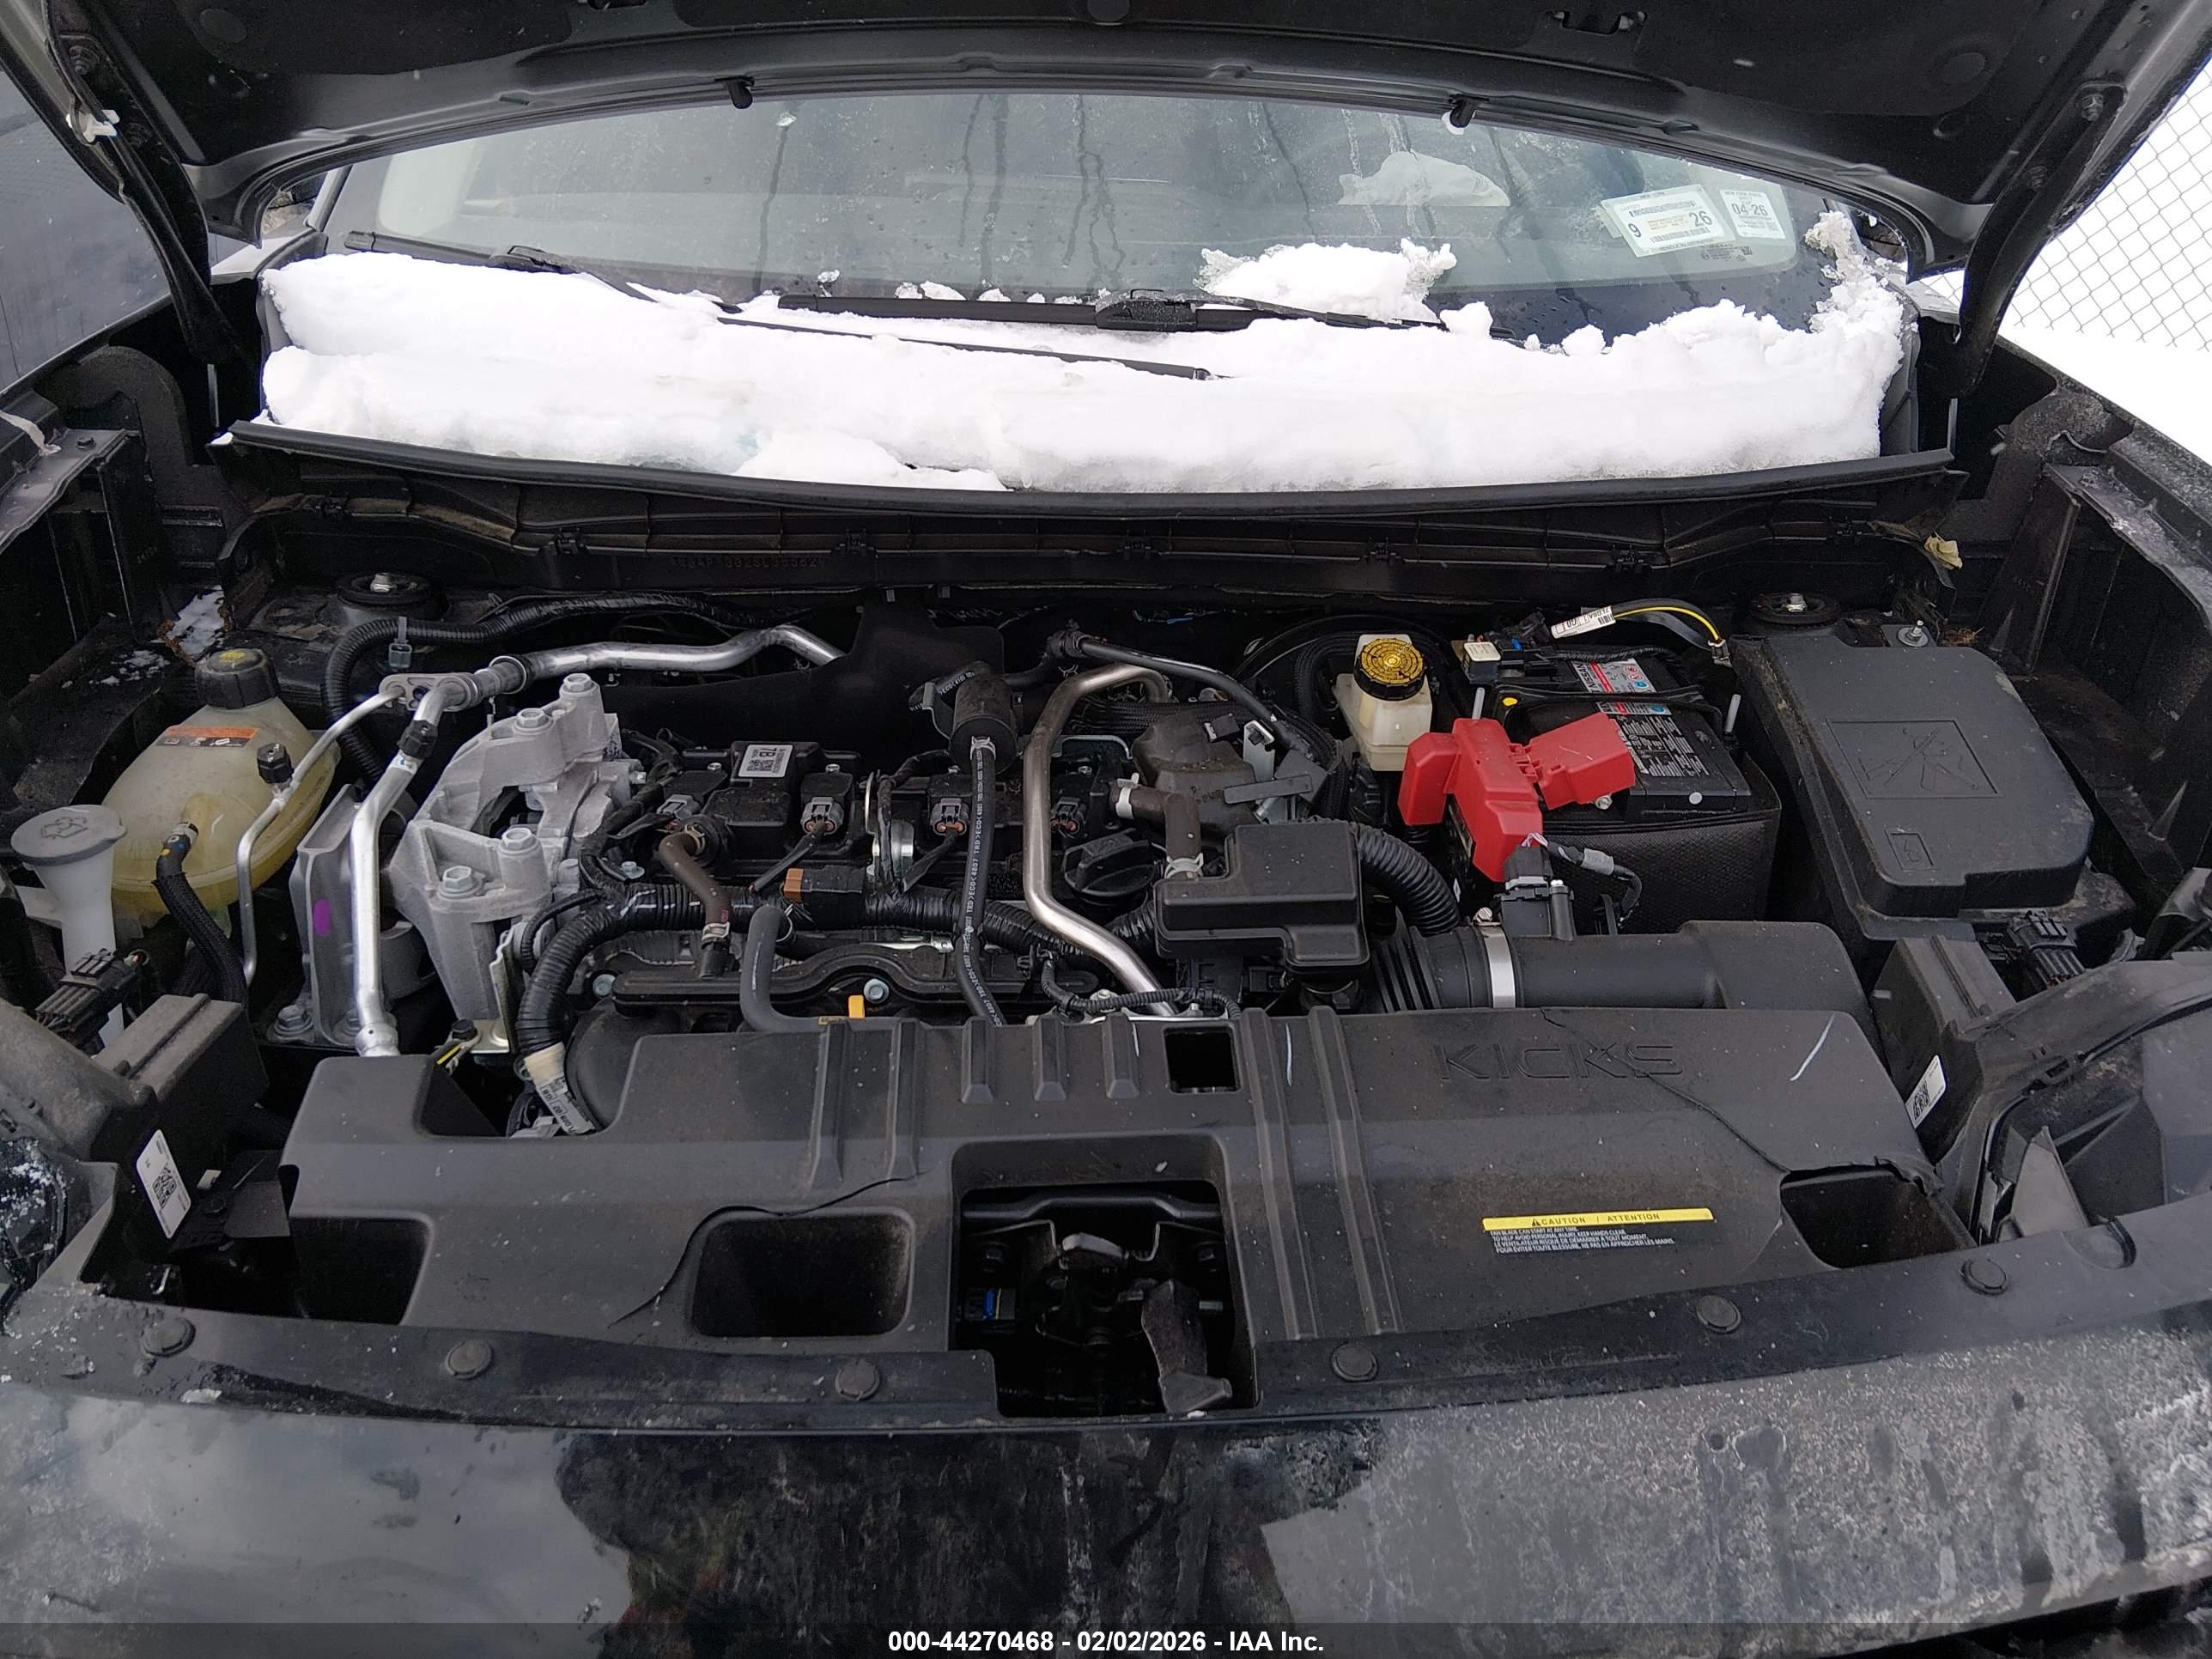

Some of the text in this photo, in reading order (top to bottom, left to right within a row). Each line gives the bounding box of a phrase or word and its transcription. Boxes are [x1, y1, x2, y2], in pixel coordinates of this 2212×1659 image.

[1689, 210, 1712, 227] 26
[1628, 223, 1642, 238] 9
[759, 747, 777, 757] 7B
[966, 859, 979, 913] TRD>ECO<4807
[1433, 1043, 1683, 1079] KICKS
[1607, 1213, 1660, 1222] ATTENTION
